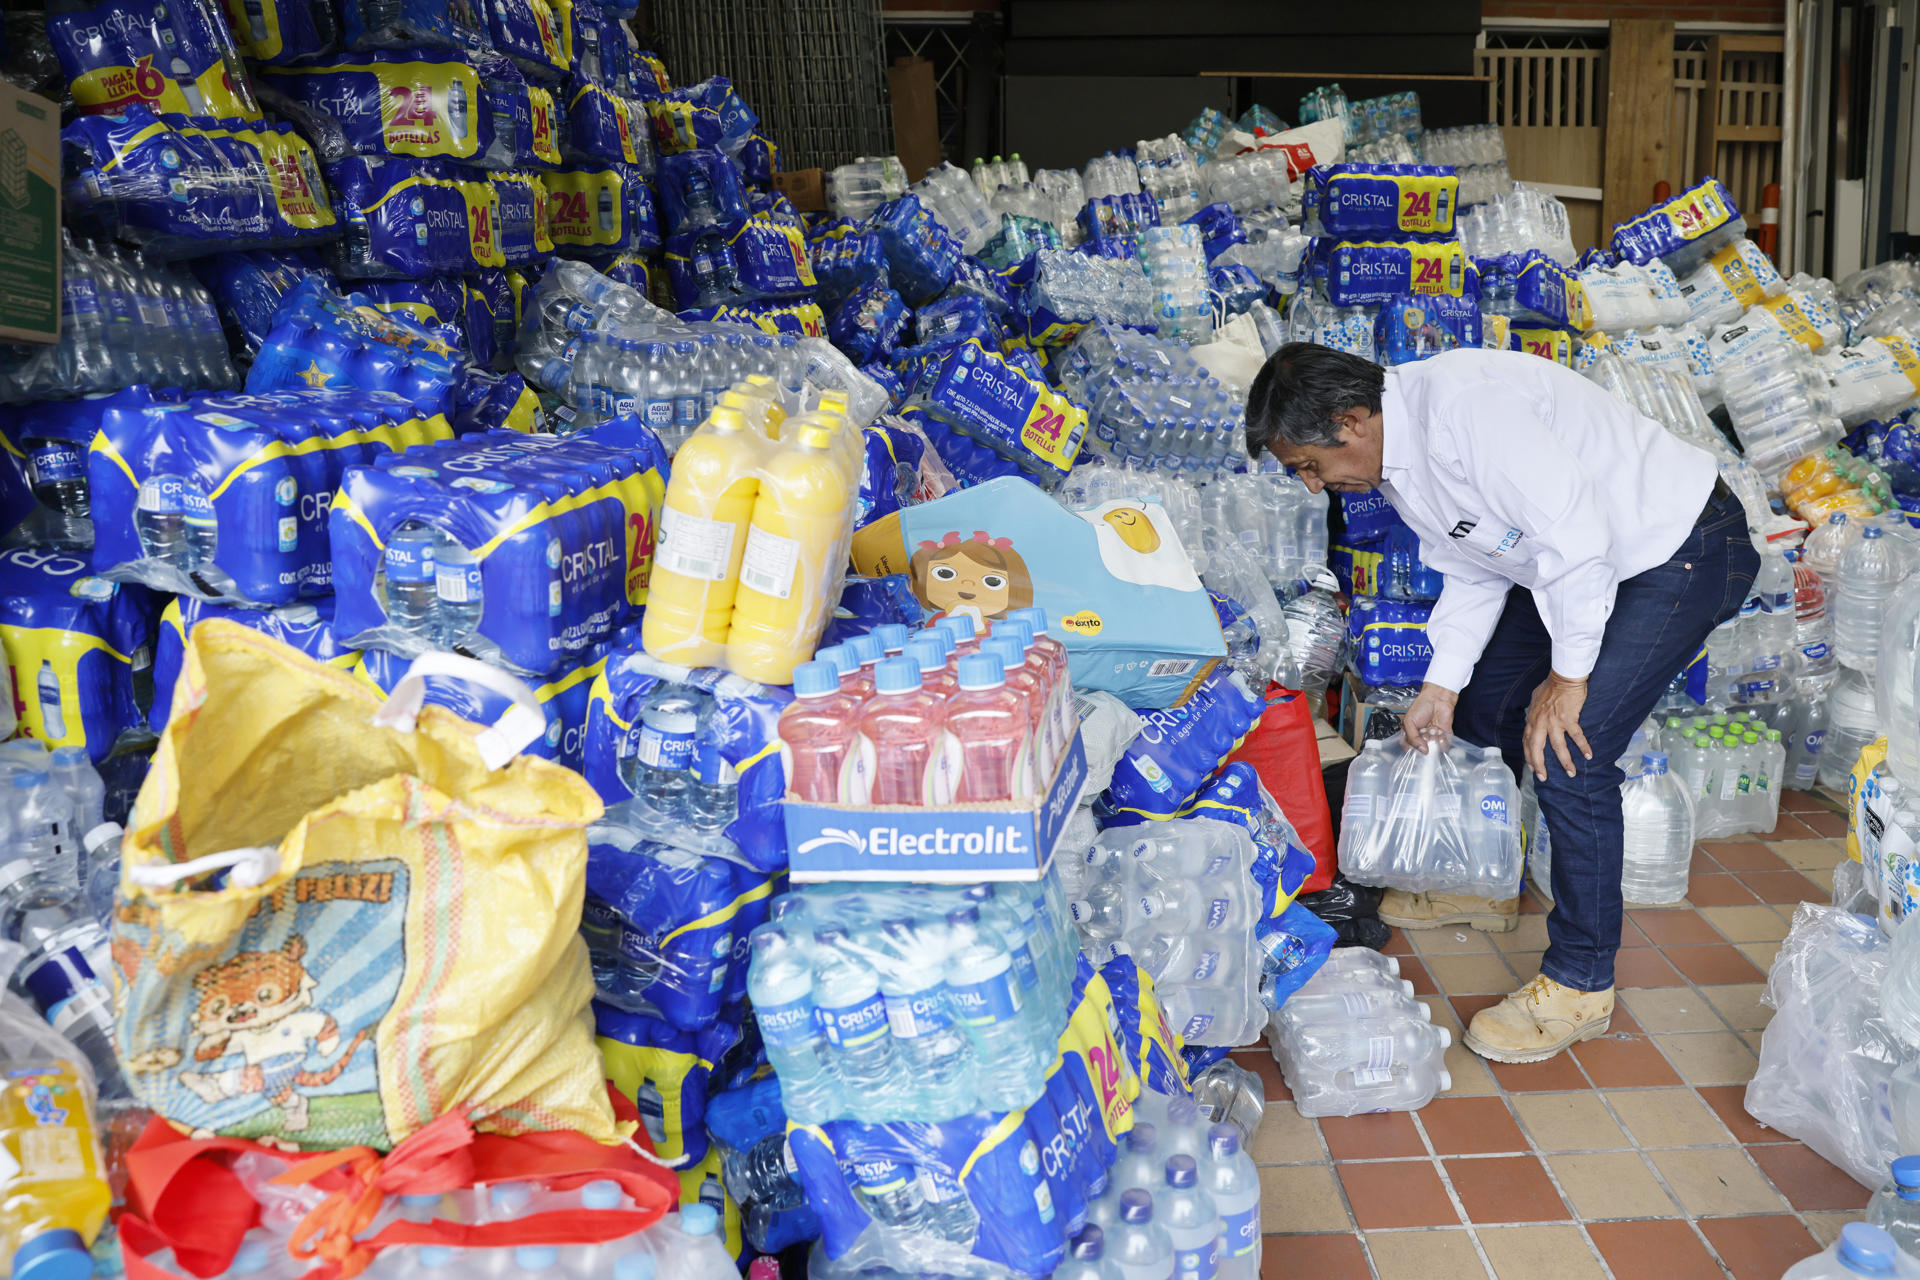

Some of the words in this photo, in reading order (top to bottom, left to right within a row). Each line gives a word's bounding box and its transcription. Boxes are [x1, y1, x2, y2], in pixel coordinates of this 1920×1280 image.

[73, 13, 152, 47] CRISTAL
[101, 72, 127, 89] PAGA
[136, 54, 165, 98] 6
[107, 83, 137, 98] LLEVA
[389, 86, 436, 126] 24
[533, 106, 550, 139] 24
[389, 130, 441, 145] BOTELLAS
[551, 192, 591, 224] 24
[1341, 193, 1393, 208] CRISTAL
[1402, 192, 1432, 217] 24
[427, 209, 466, 230] CRISTAL
[501, 203, 533, 220] CRISTAL
[1674, 202, 1704, 229] 24
[471, 206, 491, 244] 24
[550, 226, 593, 238] BOTELLAS
[1401, 219, 1432, 228] BOTELLAS
[1351, 262, 1406, 276] CRISTAL
[1415, 257, 1443, 284] 24
[1722, 258, 1743, 275] 40
[63, 284, 94, 296] ISTAL
[1440, 309, 1473, 318] CRISTAL
[1526, 341, 1553, 361] 24
[972, 366, 1025, 411] CRISTAL
[618, 401, 635, 409] AGU
[1030, 403, 1066, 442] 24
[1023, 428, 1056, 454] BOTELLAS
[36, 452, 78, 467] CRISTA
[443, 438, 563, 473] CRISTAL
[1349, 498, 1393, 514] CRISTA
[629, 512, 655, 572] 24
[562, 537, 620, 583] CRISTAL
[1354, 565, 1366, 591] 24
[1382, 642, 1434, 658] CRISTA
[1177, 720, 1195, 739] agua
[1193, 711, 1202, 722] de
[1201, 697, 1217, 713] vida
[662, 739, 693, 752] CRIS
[1481, 800, 1505, 811] OMI
[868, 825, 1023, 856] Electrolit
[1133, 842, 1147, 858] OMI
[1086, 846, 1096, 864] OMI
[1070, 903, 1080, 921] OMI
[1207, 900, 1223, 930] OMI
[624, 930, 664, 946] CRISTA
[1194, 951, 1211, 981] OMI
[837, 1001, 886, 1029] CRISTA
[1088, 1030, 1120, 1116] 24
